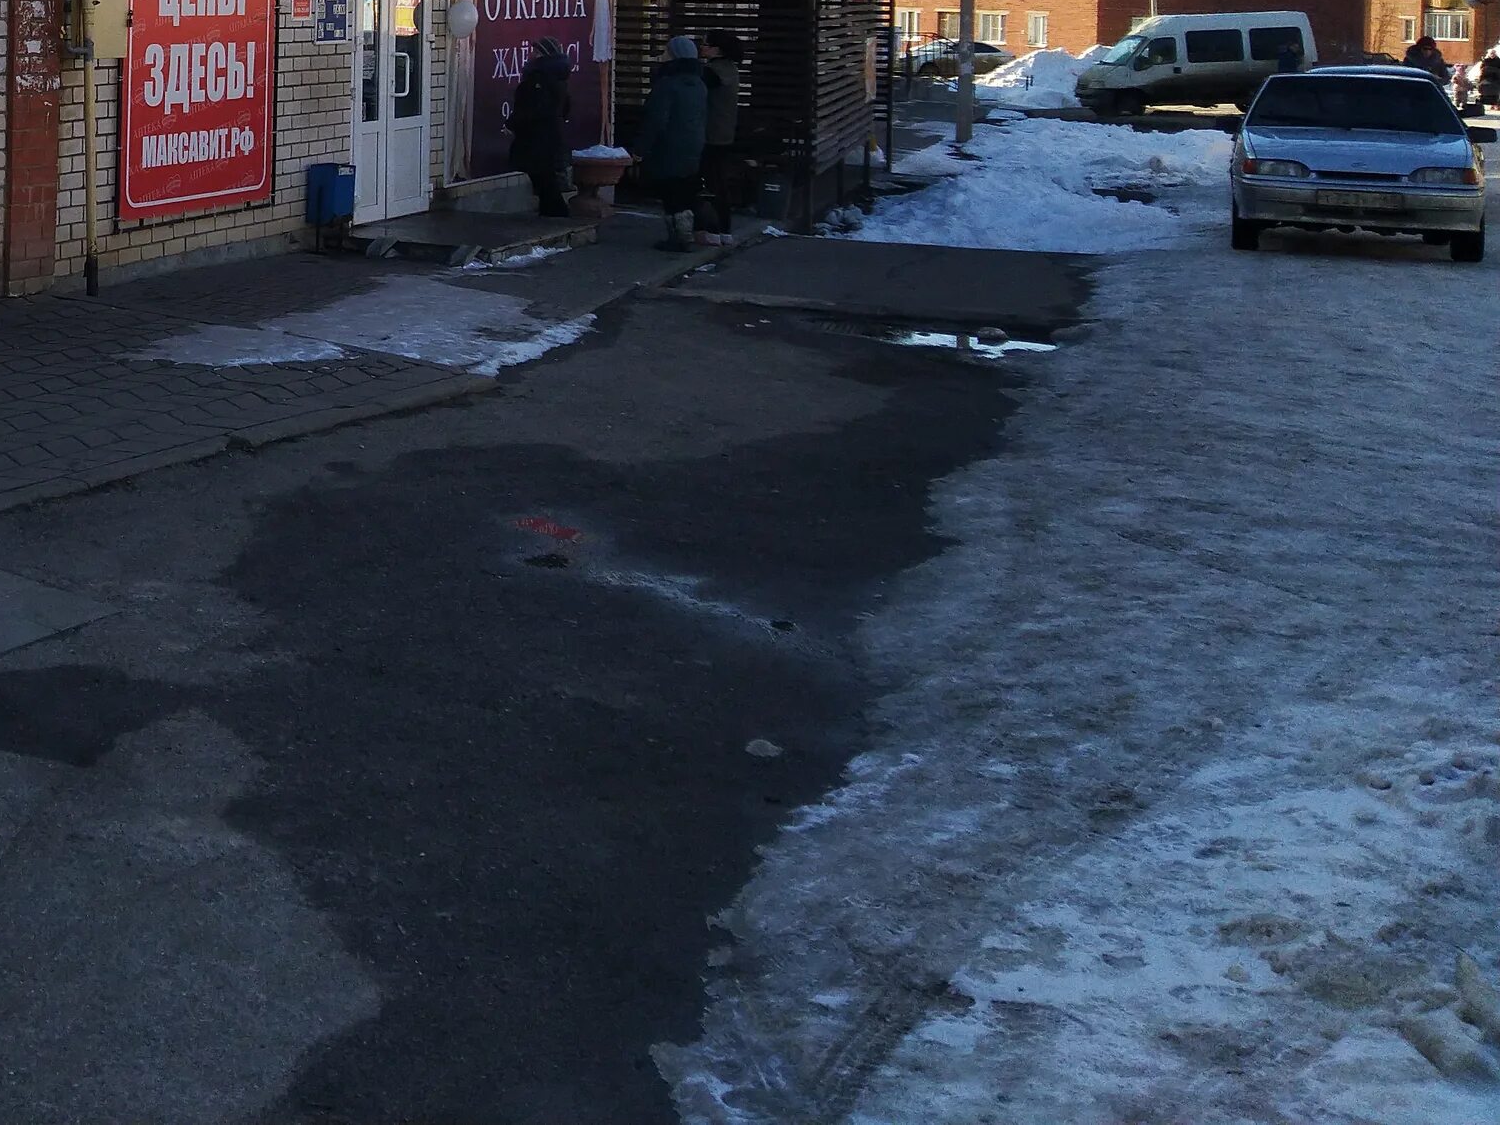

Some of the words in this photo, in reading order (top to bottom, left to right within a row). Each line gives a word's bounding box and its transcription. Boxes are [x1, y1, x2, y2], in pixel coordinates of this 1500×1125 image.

[144, 41, 256, 115] ЗДЕСЬ!
[492, 40, 533, 84] ЖДЁ
[142, 126, 255, 169] МАКСАВИТ.РФ
